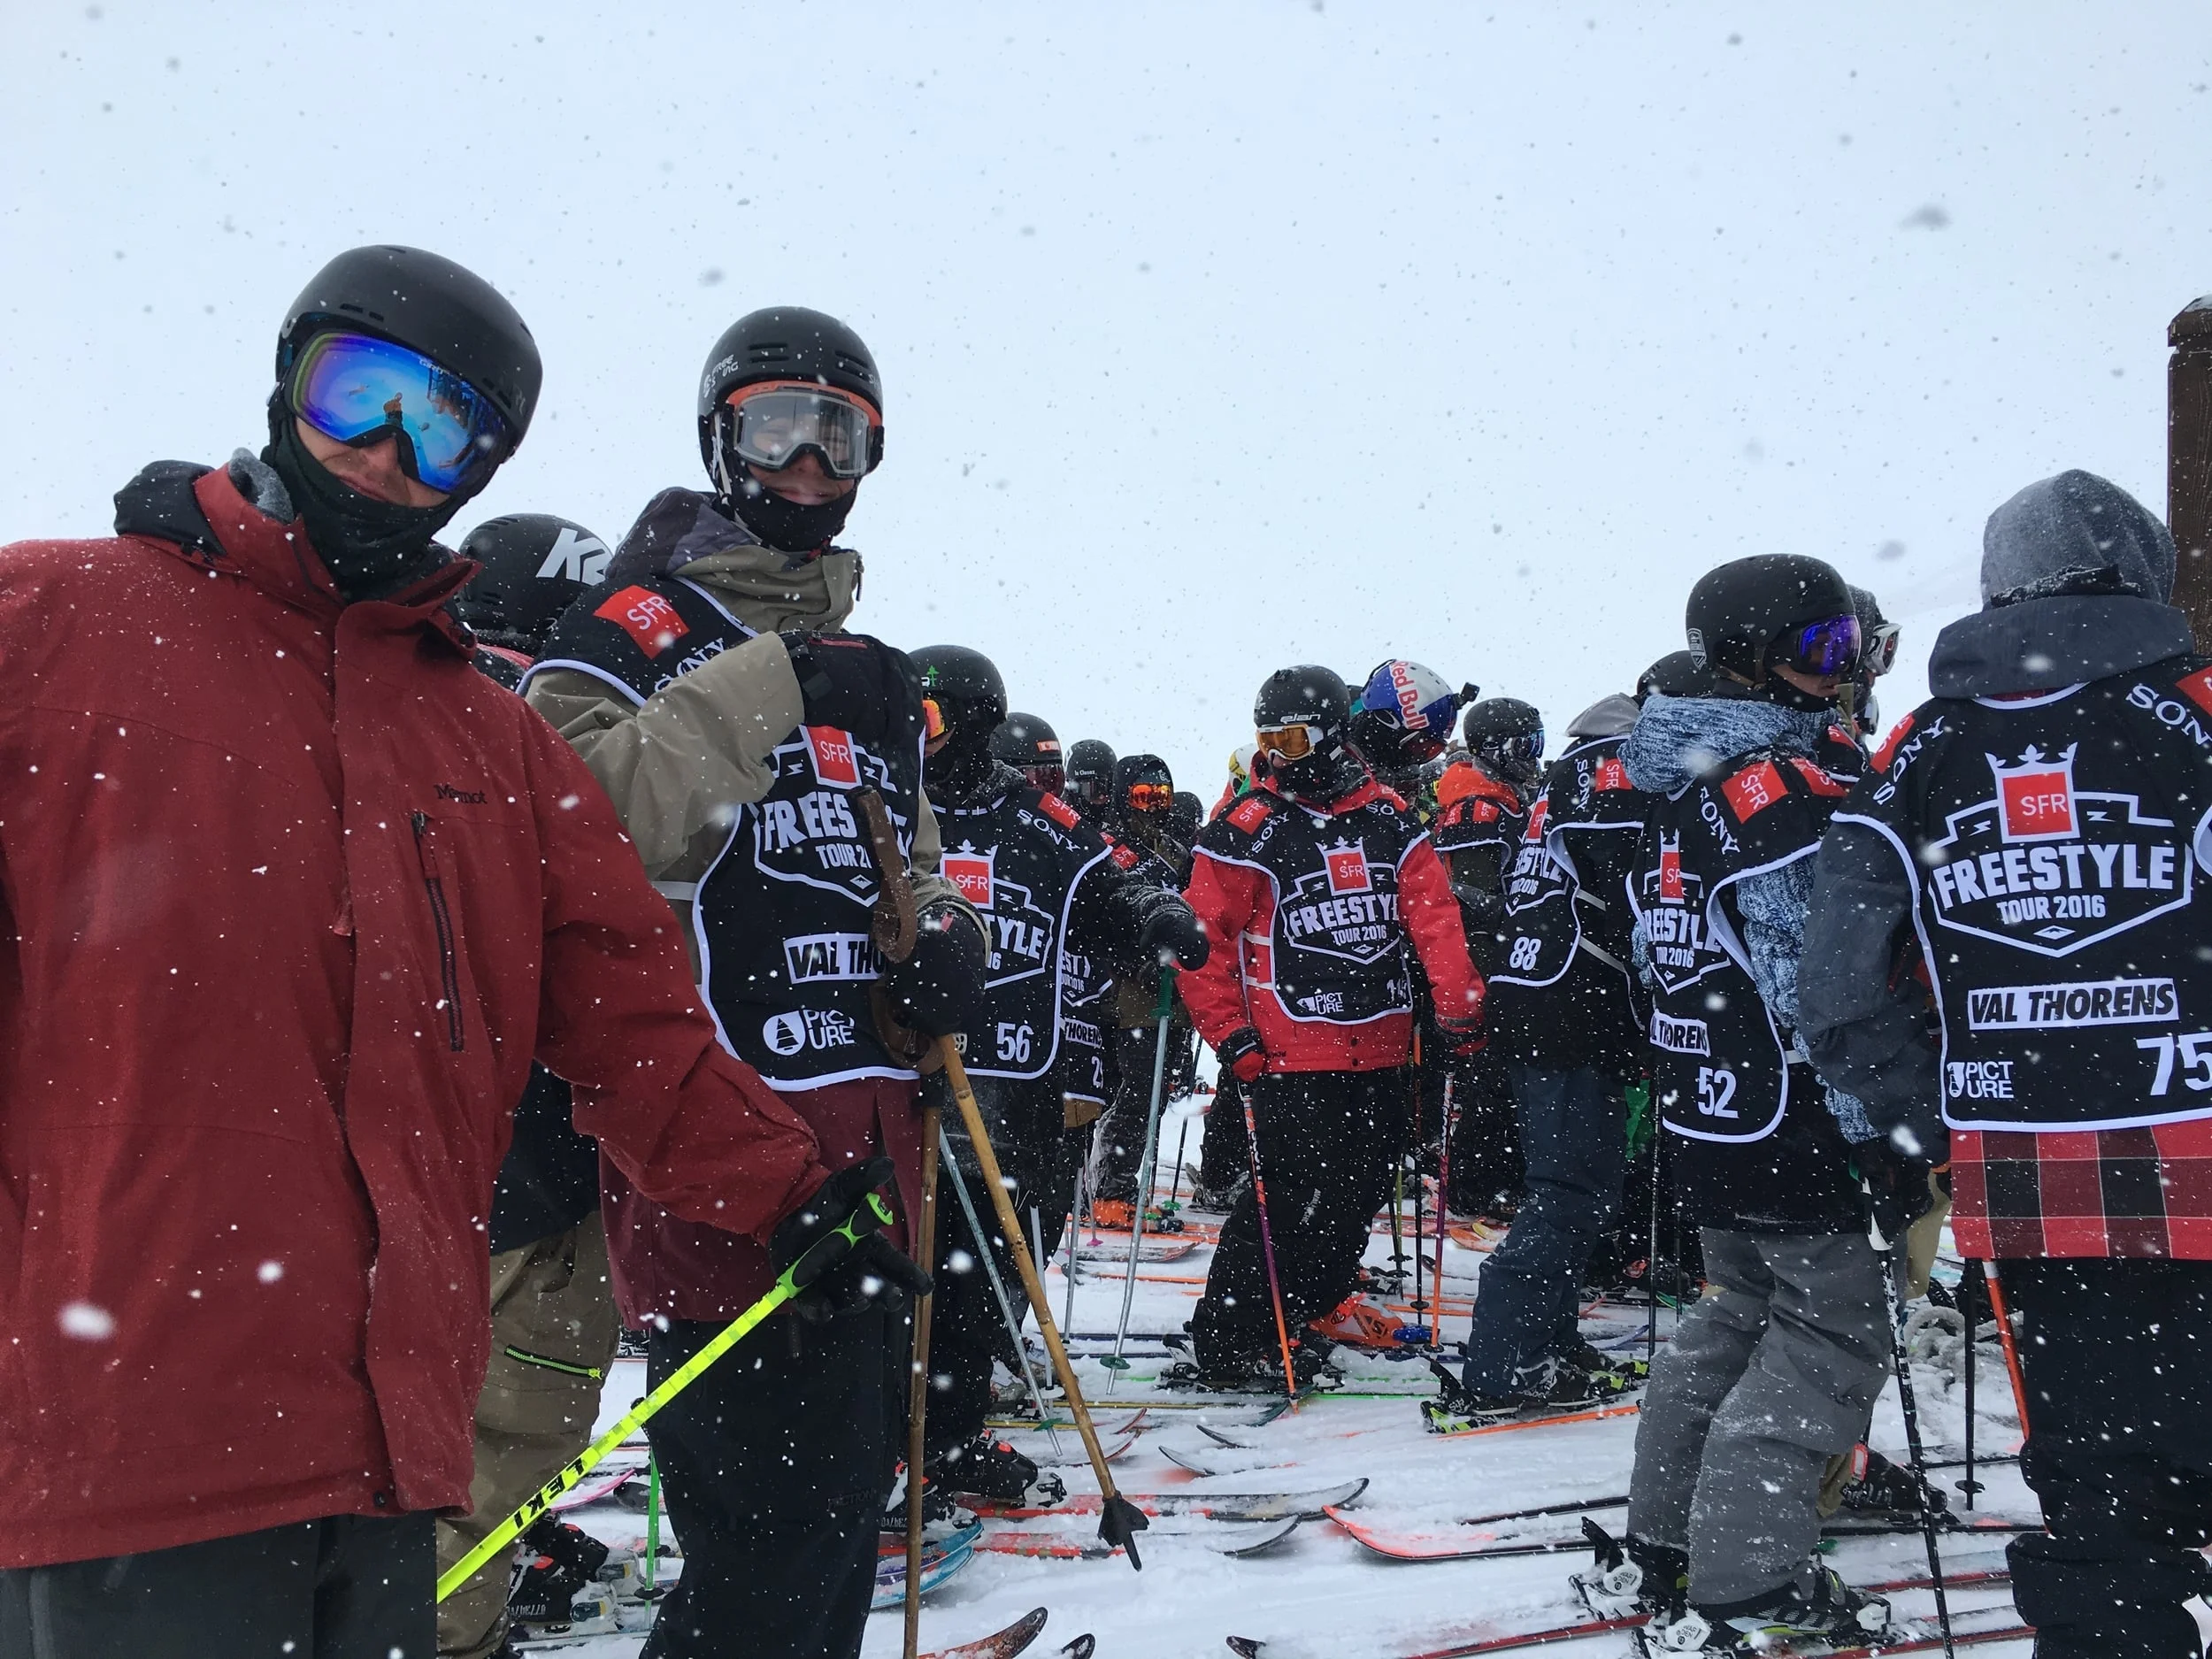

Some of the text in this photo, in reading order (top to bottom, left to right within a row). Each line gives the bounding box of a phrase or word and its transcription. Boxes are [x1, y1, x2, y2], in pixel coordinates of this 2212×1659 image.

[535, 527, 613, 586] K2
[627, 595, 672, 630] SFR
[1391, 661, 1430, 729] Red Bull
[1280, 713, 1321, 724] elan
[820, 741, 850, 764] SFR
[1873, 716, 1944, 805] SONY
[1576, 759, 1590, 812] SONY
[1606, 764, 1620, 789] SFR
[1741, 774, 1769, 810] SFR
[2021, 793, 2067, 816] SFR
[1051, 796, 1082, 821] SFR
[1239, 802, 1263, 823] SFR
[1017, 808, 1081, 852] SONY
[816, 844, 857, 869] TOUR
[956, 874, 988, 890] SFR
[1340, 864, 1364, 878] SFR
[1933, 843, 2175, 909] FREESTYLE
[1996, 895, 2106, 925] TOUR 2016
[1331, 925, 1386, 945] TOUR 2016
[788, 941, 840, 979] VAL
[1509, 936, 1541, 971] 88
[1669, 949, 1695, 968] 2016
[1315, 992, 1343, 1003] PICT
[1317, 1002, 1344, 1015] URE
[1971, 984, 2174, 1024] VAL THORENS
[808, 1025, 856, 1050] URE
[996, 1022, 1034, 1063] 56
[1965, 1062, 2014, 1080] PICT
[2136, 1033, 2212, 1095] 75
[1697, 1067, 1740, 1118] 52
[1966, 1080, 2015, 1099] URE
